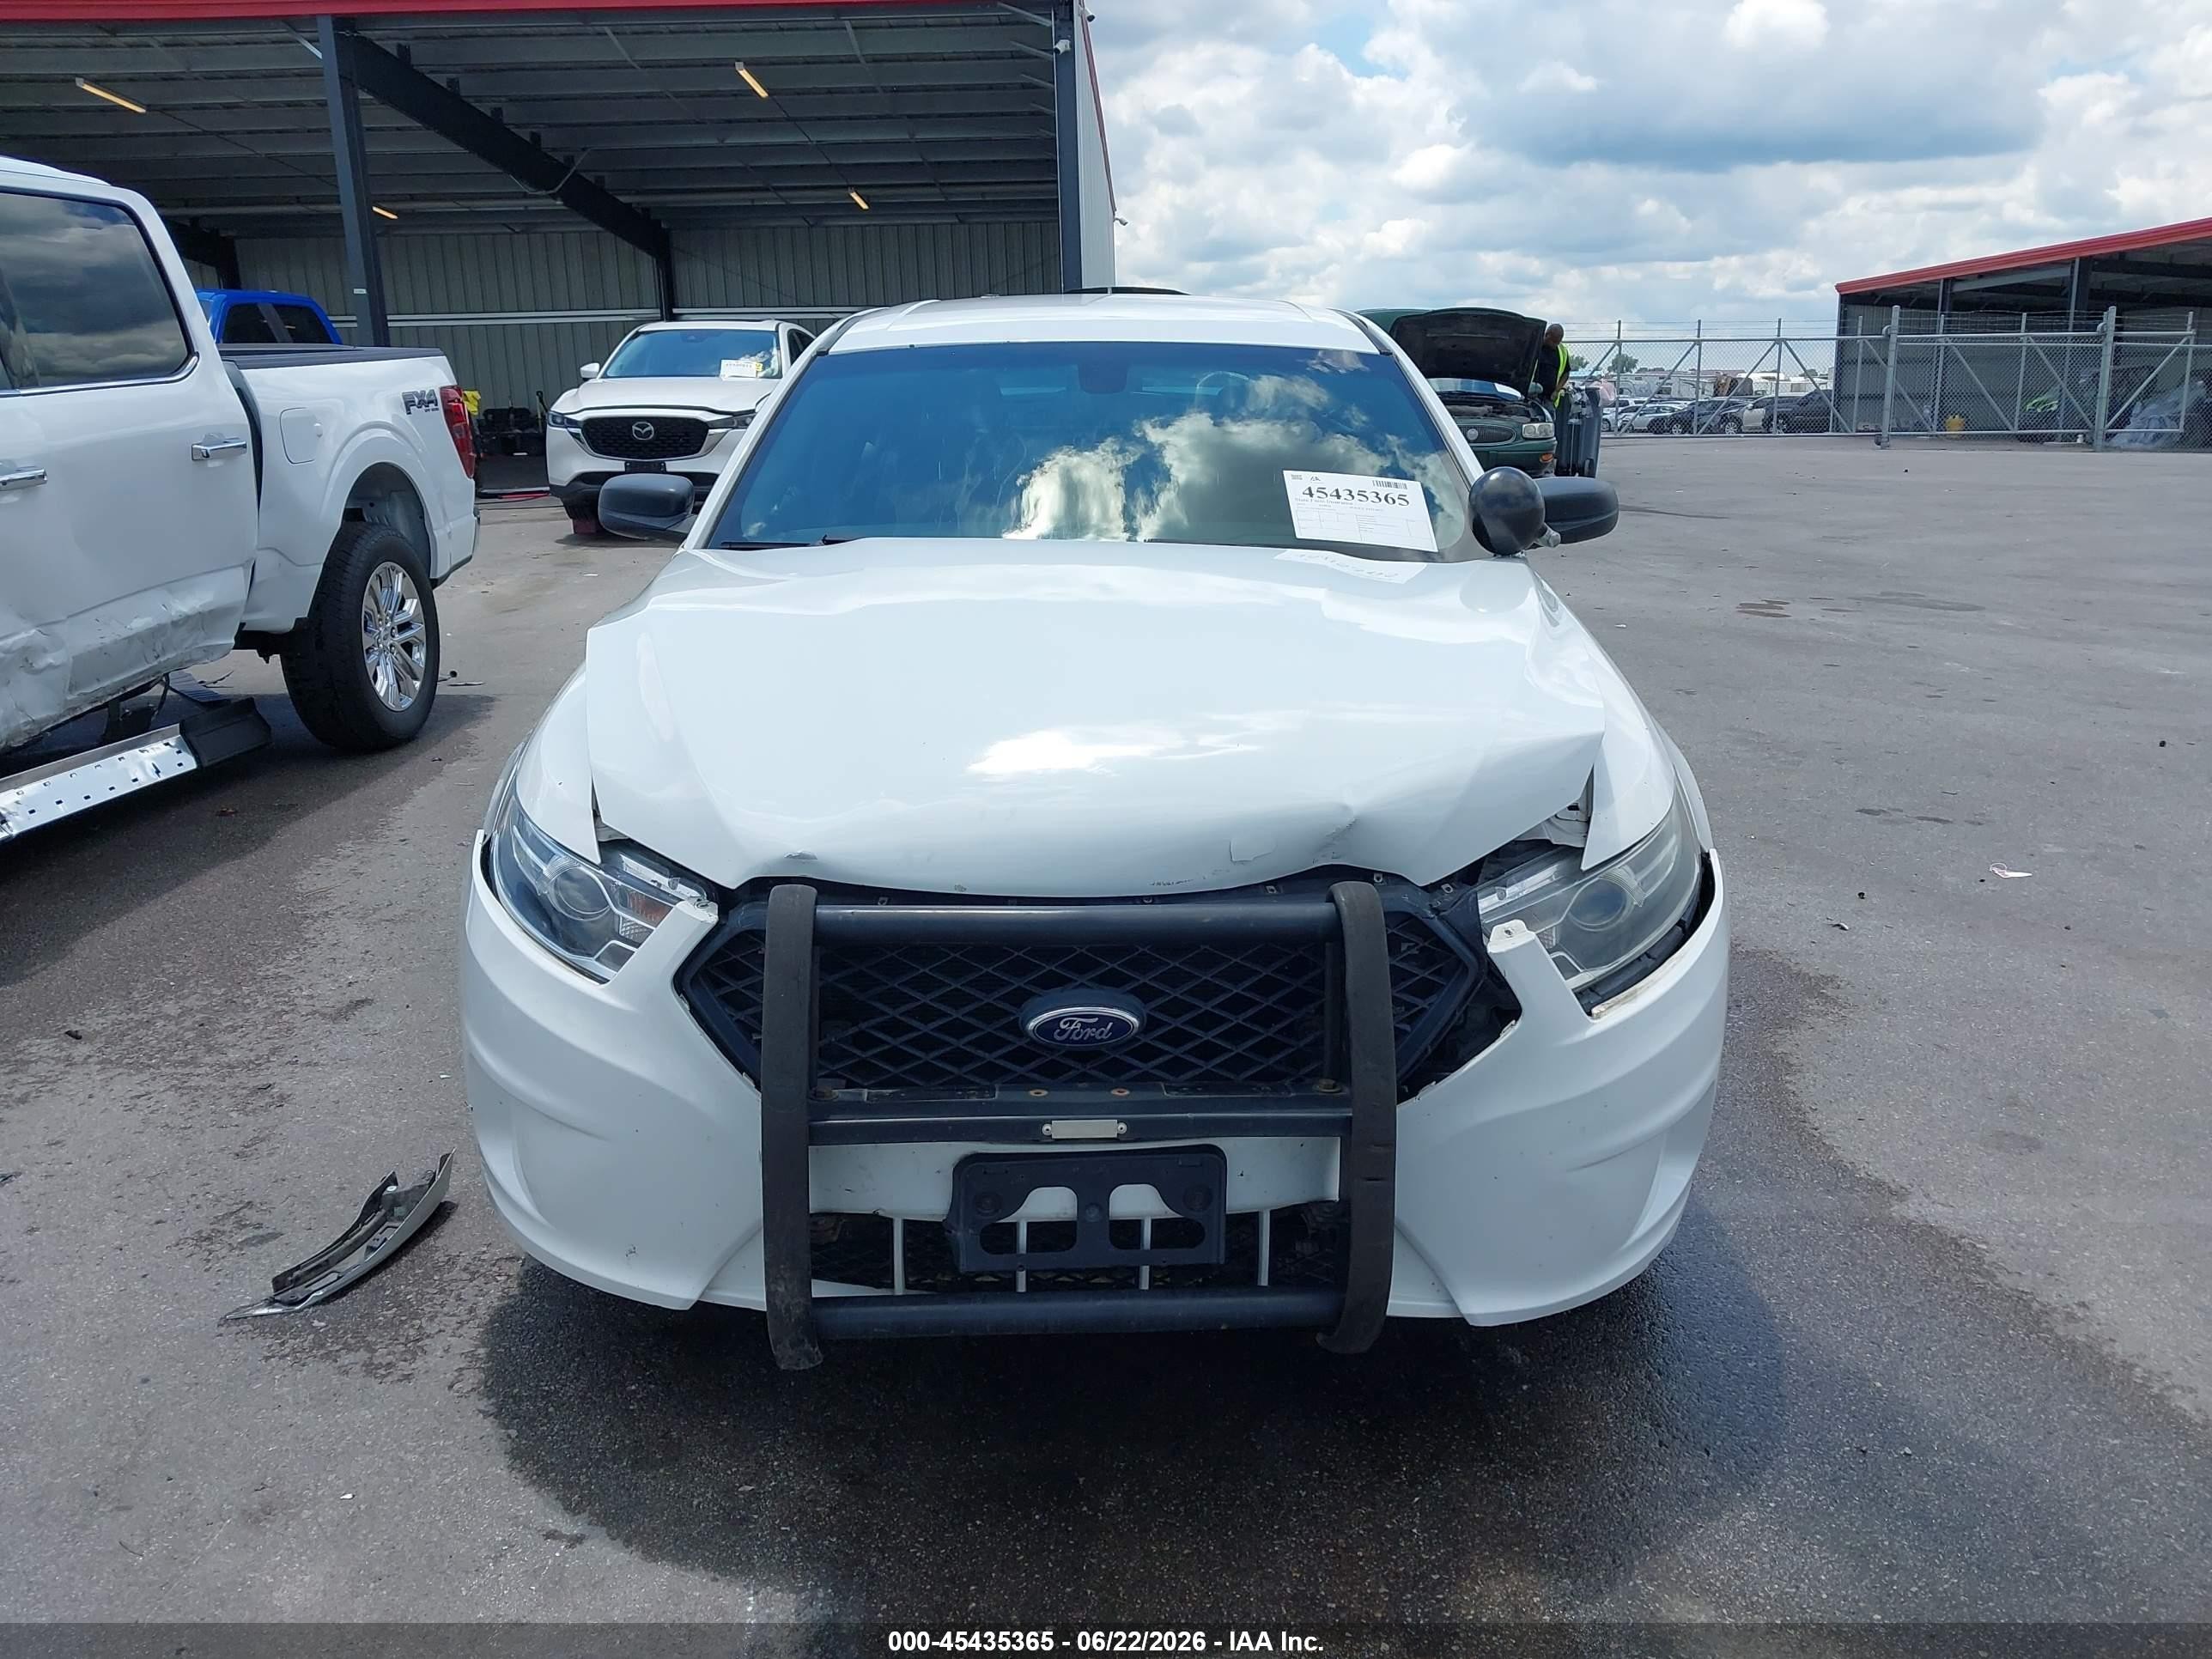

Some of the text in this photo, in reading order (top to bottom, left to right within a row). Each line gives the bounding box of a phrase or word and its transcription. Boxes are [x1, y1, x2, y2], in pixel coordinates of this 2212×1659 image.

[402, 389, 438, 415] FX4
[1302, 486, 1410, 507] 45435365
[1054, 1018, 1114, 1041] Ford
